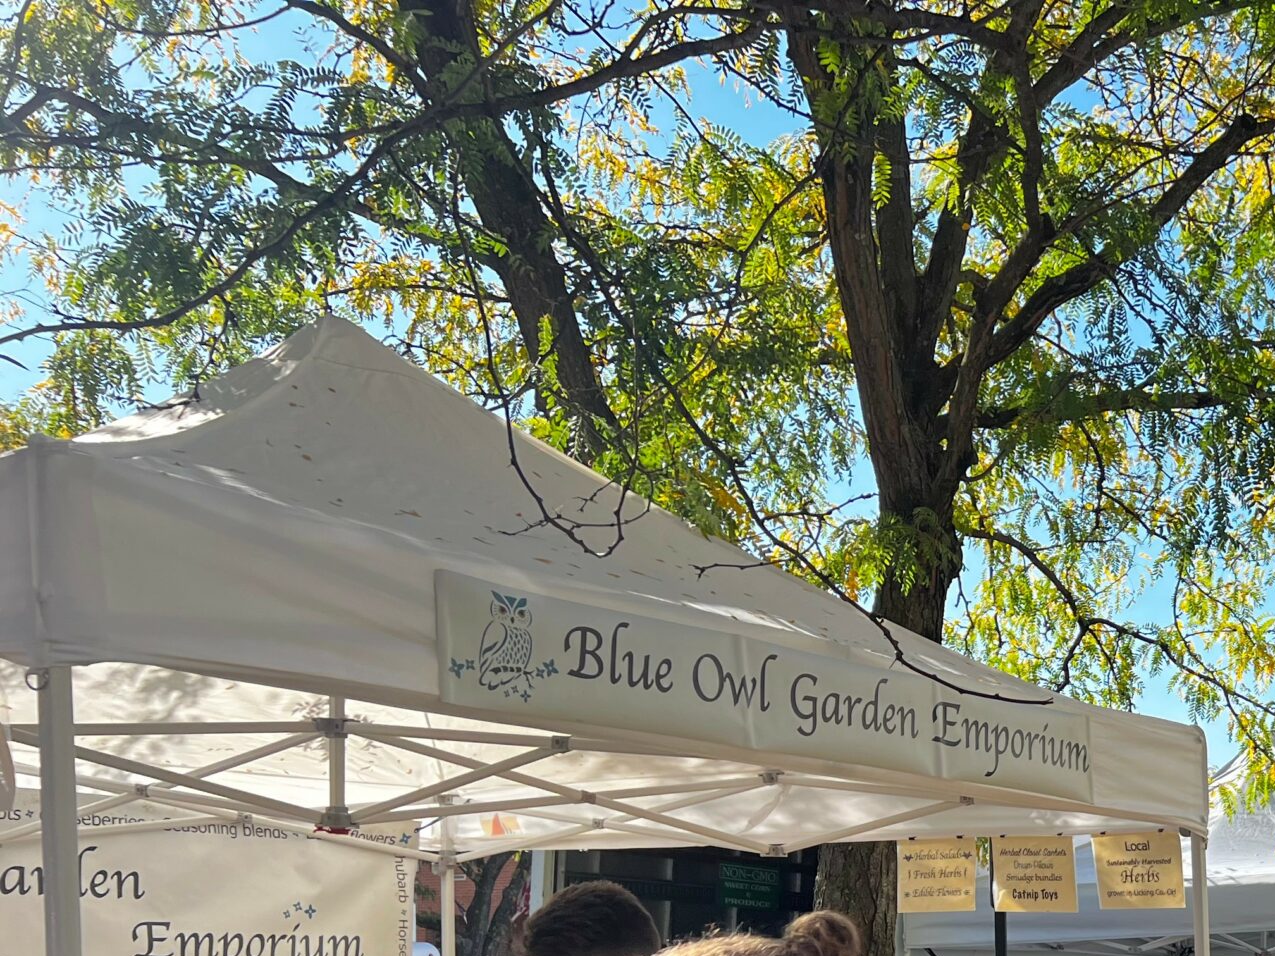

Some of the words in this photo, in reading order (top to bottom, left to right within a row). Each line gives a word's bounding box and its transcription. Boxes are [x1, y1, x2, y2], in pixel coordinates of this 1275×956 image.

[564, 622, 674, 694] Blue
[693, 653, 778, 712] Owl
[791, 674, 919, 739] Garden
[931, 701, 1091, 778] Emporium
[1124, 840, 1151, 852] Local
[1141, 857, 1172, 865] Harvested
[722, 866, 776, 882] NON-GMO
[913, 867, 936, 879] Fresh
[938, 866, 962, 878] Herbs
[1006, 873, 1034, 885] Smudge
[1035, 873, 1063, 882] bundles
[1120, 865, 1160, 884] Herbs
[394, 855, 409, 904] hubarb
[1012, 888, 1039, 902] Catnip
[1040, 888, 1059, 902] Toys
[724, 898, 771, 908] PRODUCE
